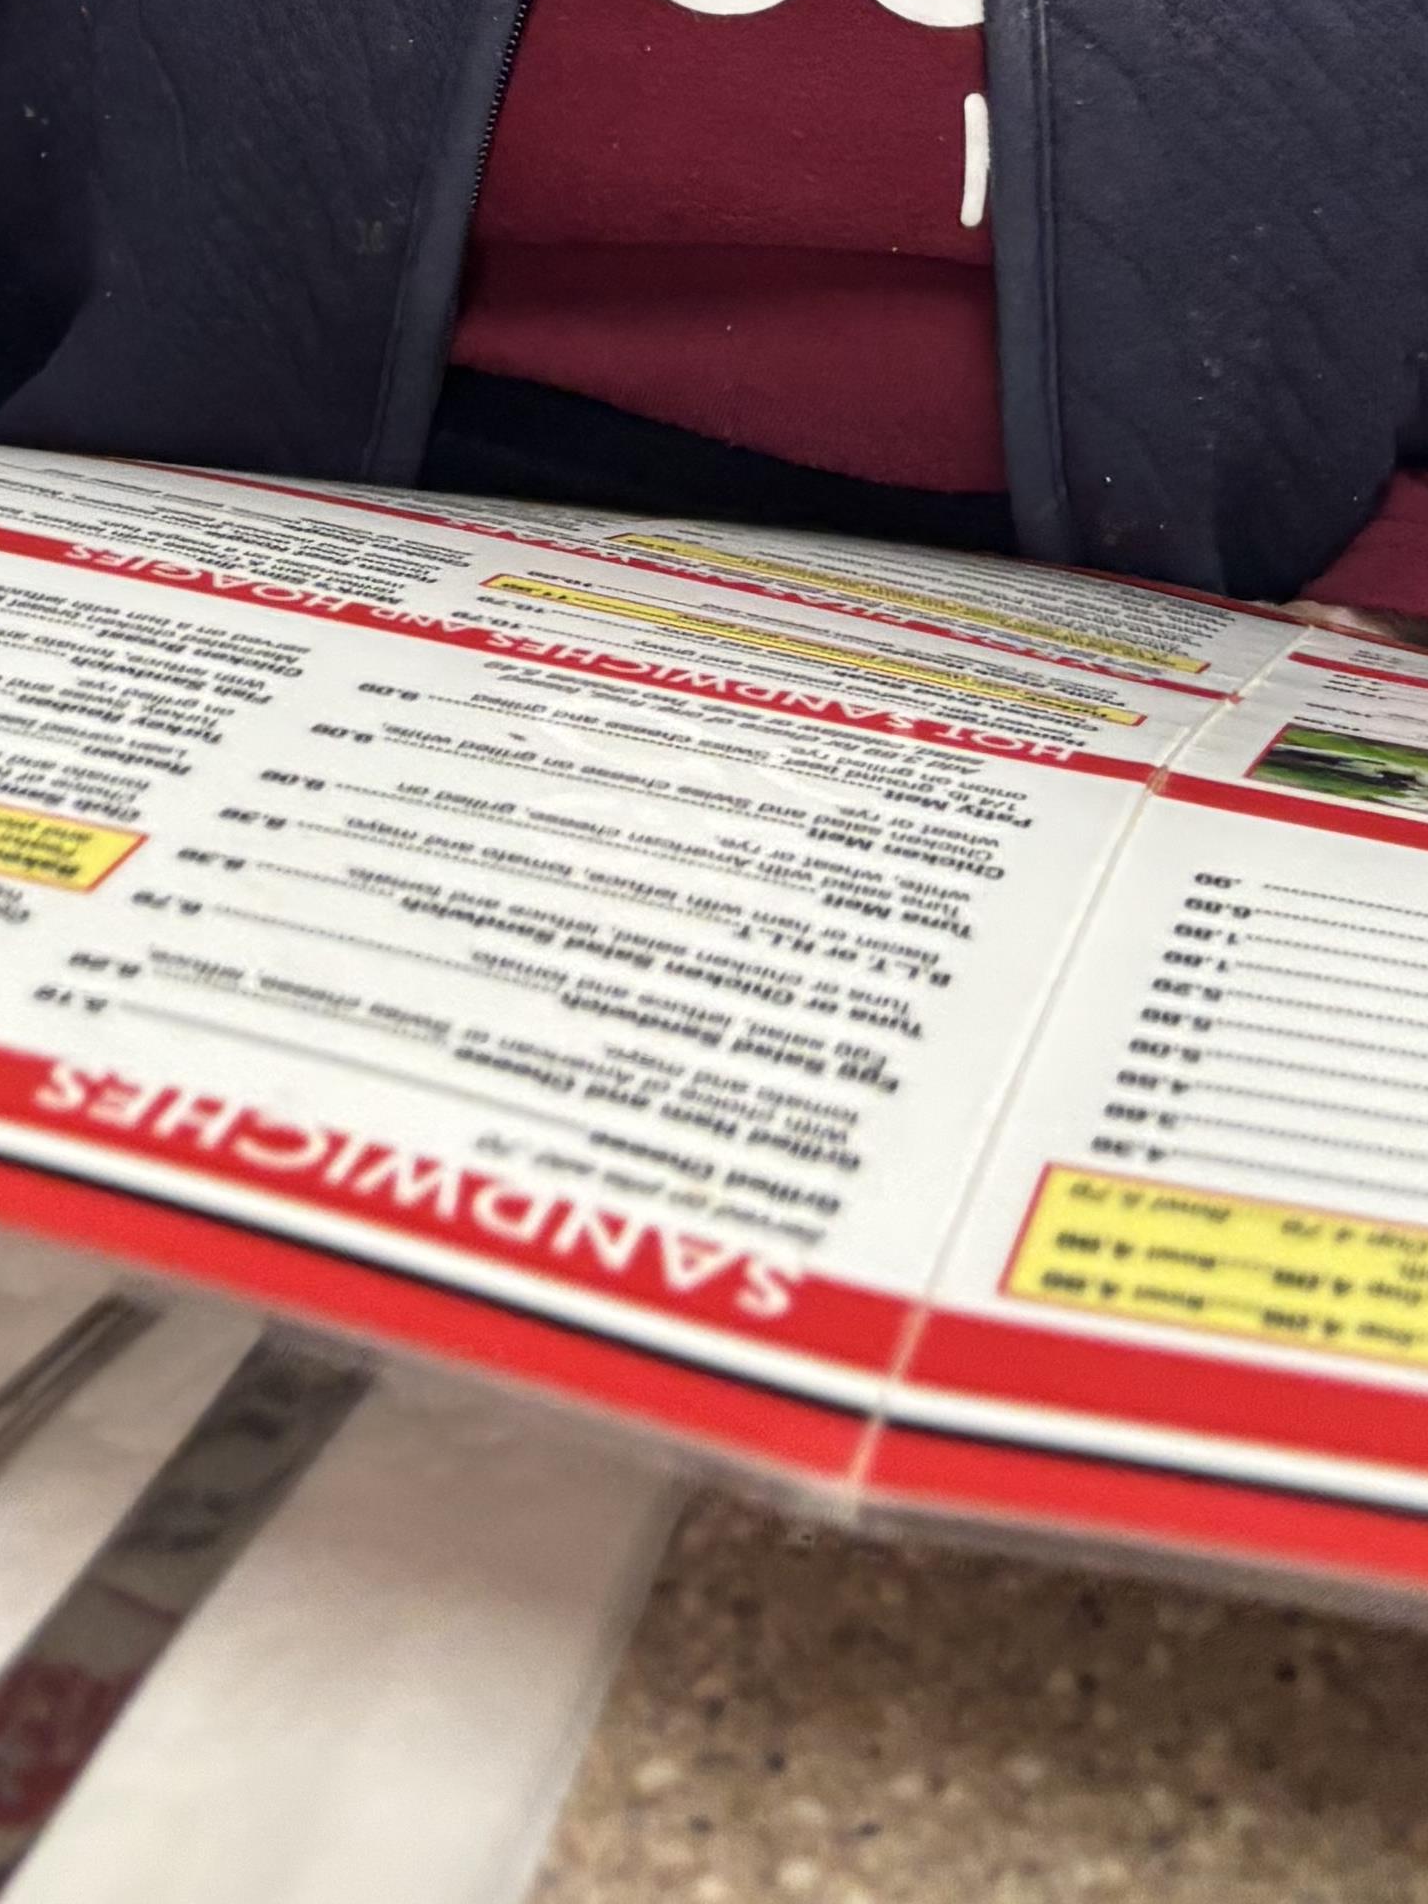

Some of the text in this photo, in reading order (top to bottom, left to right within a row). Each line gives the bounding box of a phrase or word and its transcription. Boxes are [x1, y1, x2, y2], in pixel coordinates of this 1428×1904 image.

[8, 599, 80, 621] breast
[72, 600, 120, 618] with
[127, 611, 171, 628] bun
[87, 614, 176, 641] chicken
[197, 626, 227, 639] on
[33, 635, 115, 659] tomato
[64, 543, 1077, 761] HOT SANDWICHES AND HOAGIES
[96, 628, 303, 680] Chicken Breast
[231, 633, 310, 656] served
[69, 656, 273, 707] Fish Sandwich
[213, 672, 266, 690] With
[470, 691, 548, 717] grilled
[553, 708, 599, 728] and
[17, 694, 221, 746] Turkey Reuben
[604, 718, 692, 747] cheese
[81, 745, 192, 778] Reuben
[457, 737, 538, 766] grilled
[543, 756, 574, 772] on
[698, 737, 770, 762] Swiss
[580, 764, 670, 793] cheese
[837, 754, 915, 781] grilled
[845, 765, 934, 797] ground
[920, 772, 952, 788] on
[397, 781, 429, 797] on
[435, 788, 517, 817] grilled
[883, 788, 949, 813] Melt
[957, 780, 1027, 803] onion
[974, 794, 1018, 813] 1/4
[758, 801, 807, 822] and
[887, 816, 915, 832] or
[958, 801, 1033, 830] Patty
[806, 825, 873, 854] Melt
[813, 813, 884, 840] salad
[921, 823, 999, 850] wheat
[425, 833, 474, 856] and
[628, 831, 753, 876] American
[767, 847, 796, 865] or
[891, 831, 994, 864] Chicken
[479, 845, 573, 878] tomato
[757, 861, 813, 889] with
[801, 854, 883, 887] wheat
[883, 842, 1005, 883] Chicken
[820, 875, 893, 907] salad
[685, 893, 744, 922] with
[822, 891, 892, 922] Melt
[901, 893, 959, 921] Tuna
[399, 895, 555, 950] Sandwich
[750, 908, 811, 937] ham
[820, 924, 848, 945] or
[901, 909, 972, 941] Tuna
[562, 934, 654, 973] Salad
[823, 944, 858, 964] or
[855, 933, 939, 968] Bacon
[663, 959, 795, 1011] Chicken
[805, 995, 838, 1017] or
[561, 992, 723, 1051] Sandwich
[849, 1005, 922, 1041] Tuna
[730, 1035, 826, 1078] Salad
[454, 1046, 576, 1099] Cheese
[836, 1058, 899, 1097] Egg
[588, 1129, 714, 1186] Cheese
[747, 1128, 861, 1175] Grilled
[33, 1062, 806, 1319] SANDWICHES
[724, 1166, 841, 1222] Grilled
